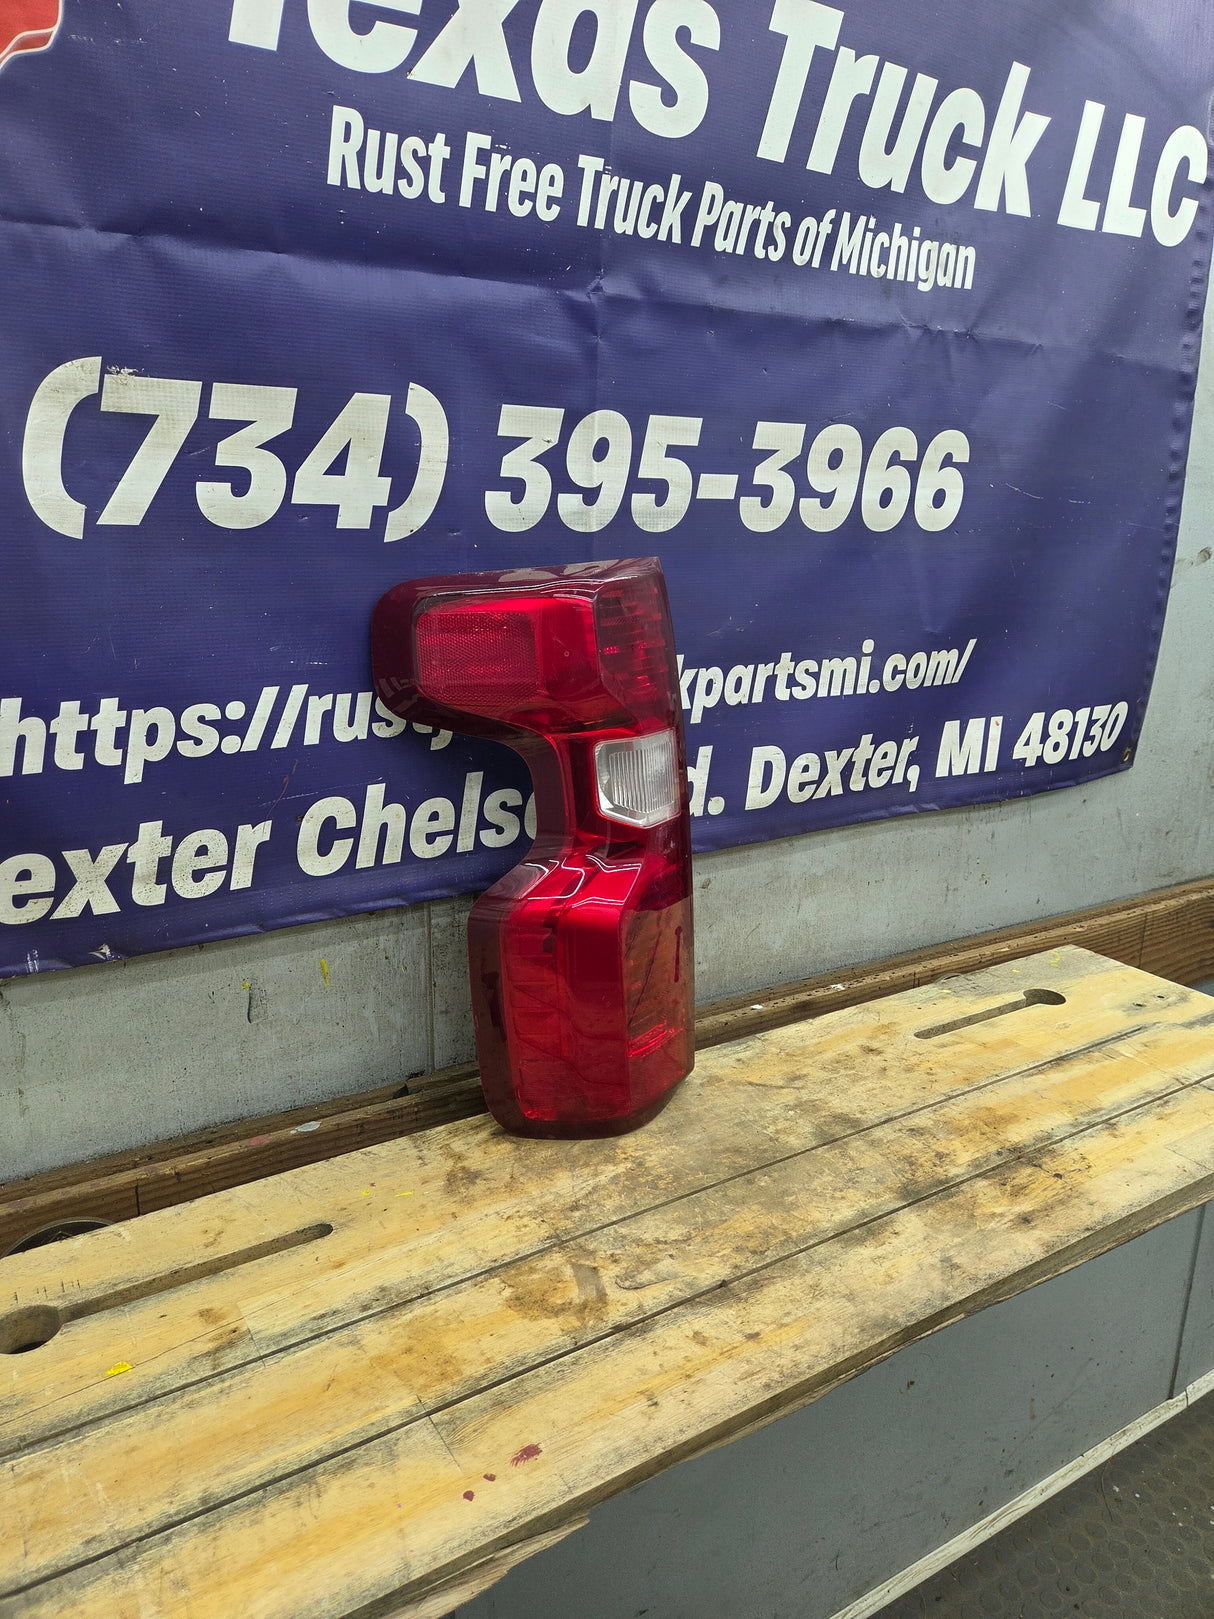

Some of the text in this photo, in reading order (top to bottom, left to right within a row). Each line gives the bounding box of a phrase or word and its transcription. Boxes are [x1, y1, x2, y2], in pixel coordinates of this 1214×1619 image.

[228, 0, 1208, 248] exas Truck LLC
[327, 105, 976, 293] Rust Free Truck Parts of Michigan
[22, 356, 970, 543] (734) 395-3966
[745, 734, 920, 811] Dexter,
[935, 716, 1003, 778] MI
[1013, 701, 1130, 769] 48130
